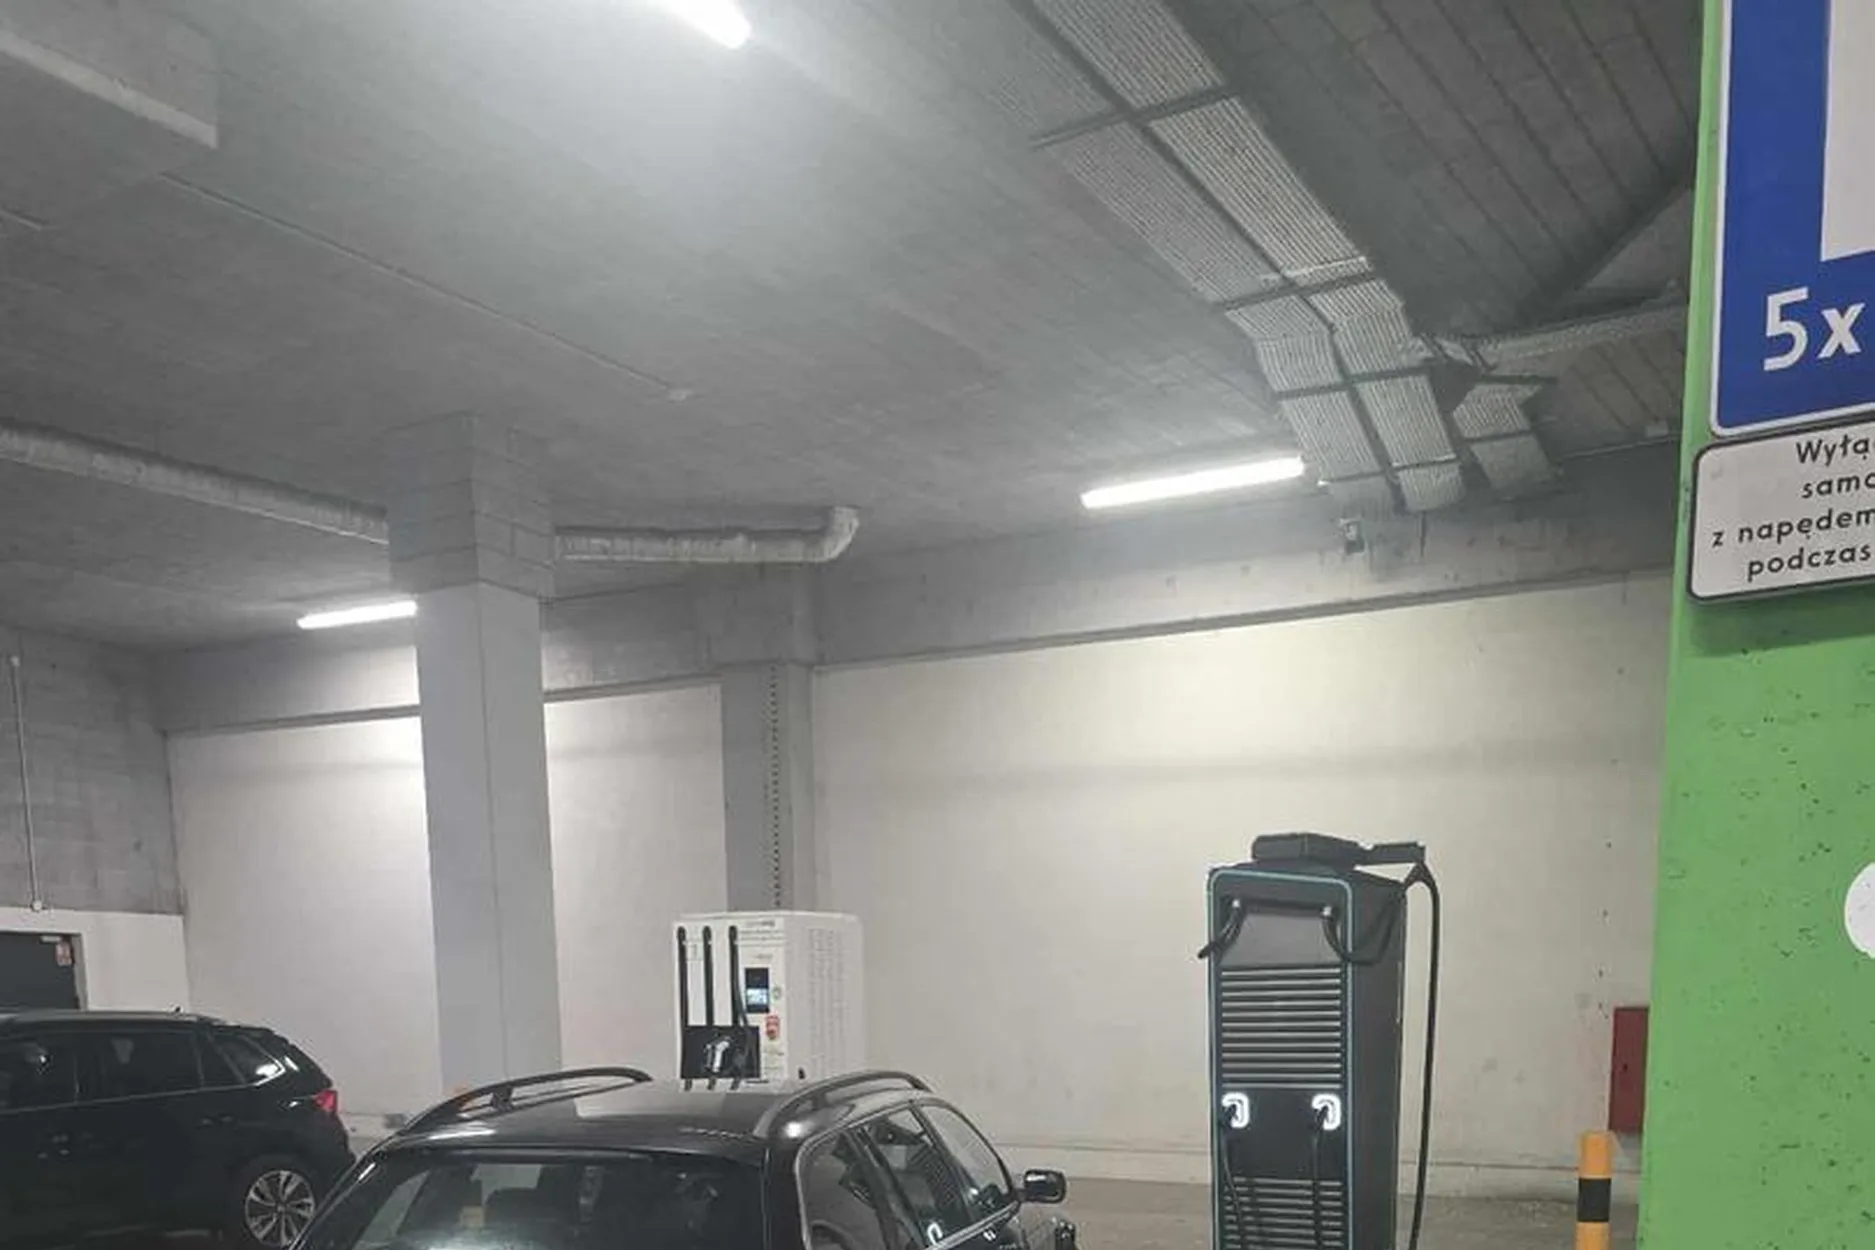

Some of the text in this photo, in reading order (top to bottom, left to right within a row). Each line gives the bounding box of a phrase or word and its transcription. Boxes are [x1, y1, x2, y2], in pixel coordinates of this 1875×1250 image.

[1796, 434, 1875, 467] Wyłą
[1712, 531, 1725, 548] z
[1748, 544, 1871, 583] podczas
